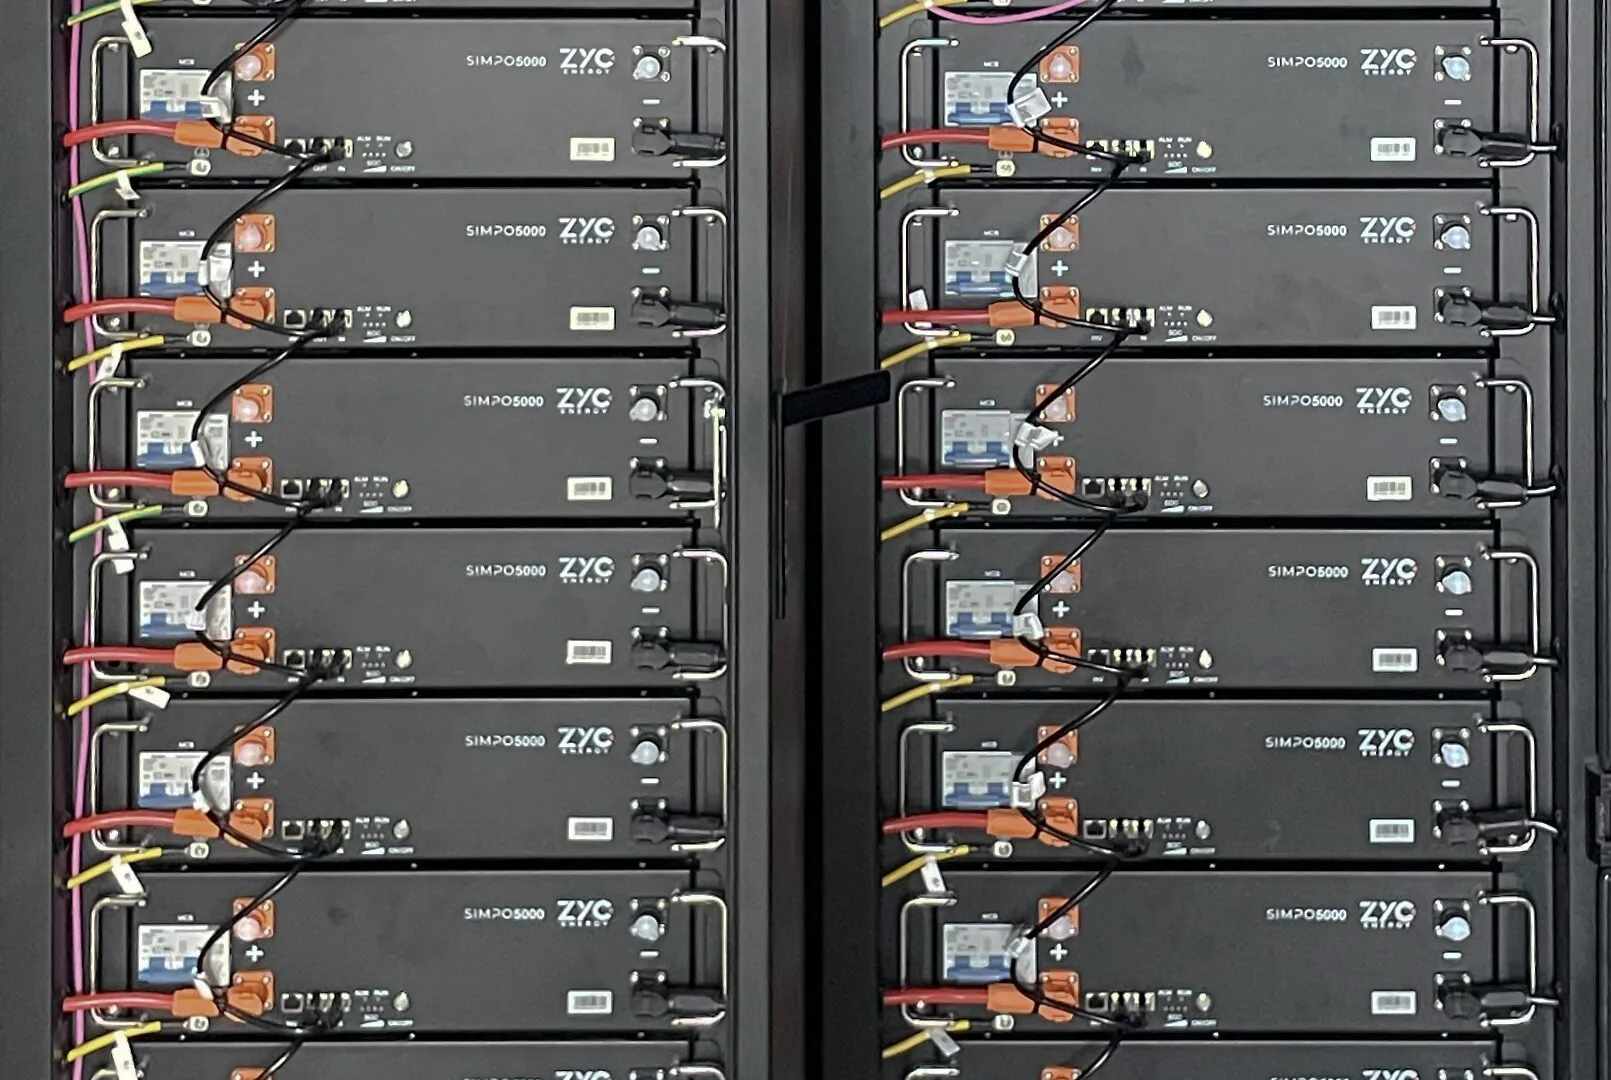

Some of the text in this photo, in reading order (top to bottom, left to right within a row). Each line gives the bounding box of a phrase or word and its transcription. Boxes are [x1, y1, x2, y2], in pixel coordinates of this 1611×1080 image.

[466, 55, 547, 68] SIMPO5000
[559, 47, 615, 69] ZYC
[1267, 56, 1347, 69] SIMPO5000
[1361, 48, 1416, 69] ZYC
[466, 225, 546, 238] SIMPO5000
[559, 217, 615, 238] ZYC
[1267, 224, 1347, 237] SIMPO5000
[1360, 216, 1416, 238] ZYC
[464, 395, 544, 408] SIMPO5000
[556, 388, 613, 408] ZYC
[1263, 394, 1343, 407] SIMPO5000
[1356, 387, 1412, 408] ZYC
[466, 564, 546, 577] SIMPO5000
[559, 556, 615, 578] ZYC
[1268, 565, 1348, 578] SIMPO5000
[1361, 558, 1418, 579] ZYC
[465, 735, 546, 748] SIMPO5000
[558, 727, 615, 748] ZYC
[1265, 736, 1346, 749] SIMPO5000
[1359, 728, 1415, 750] ZYC
[464, 907, 545, 920] SIMPO5000
[557, 900, 613, 921] ZYC
[1266, 908, 1347, 921] SIMPO5000
[1360, 900, 1416, 922] ZYC
